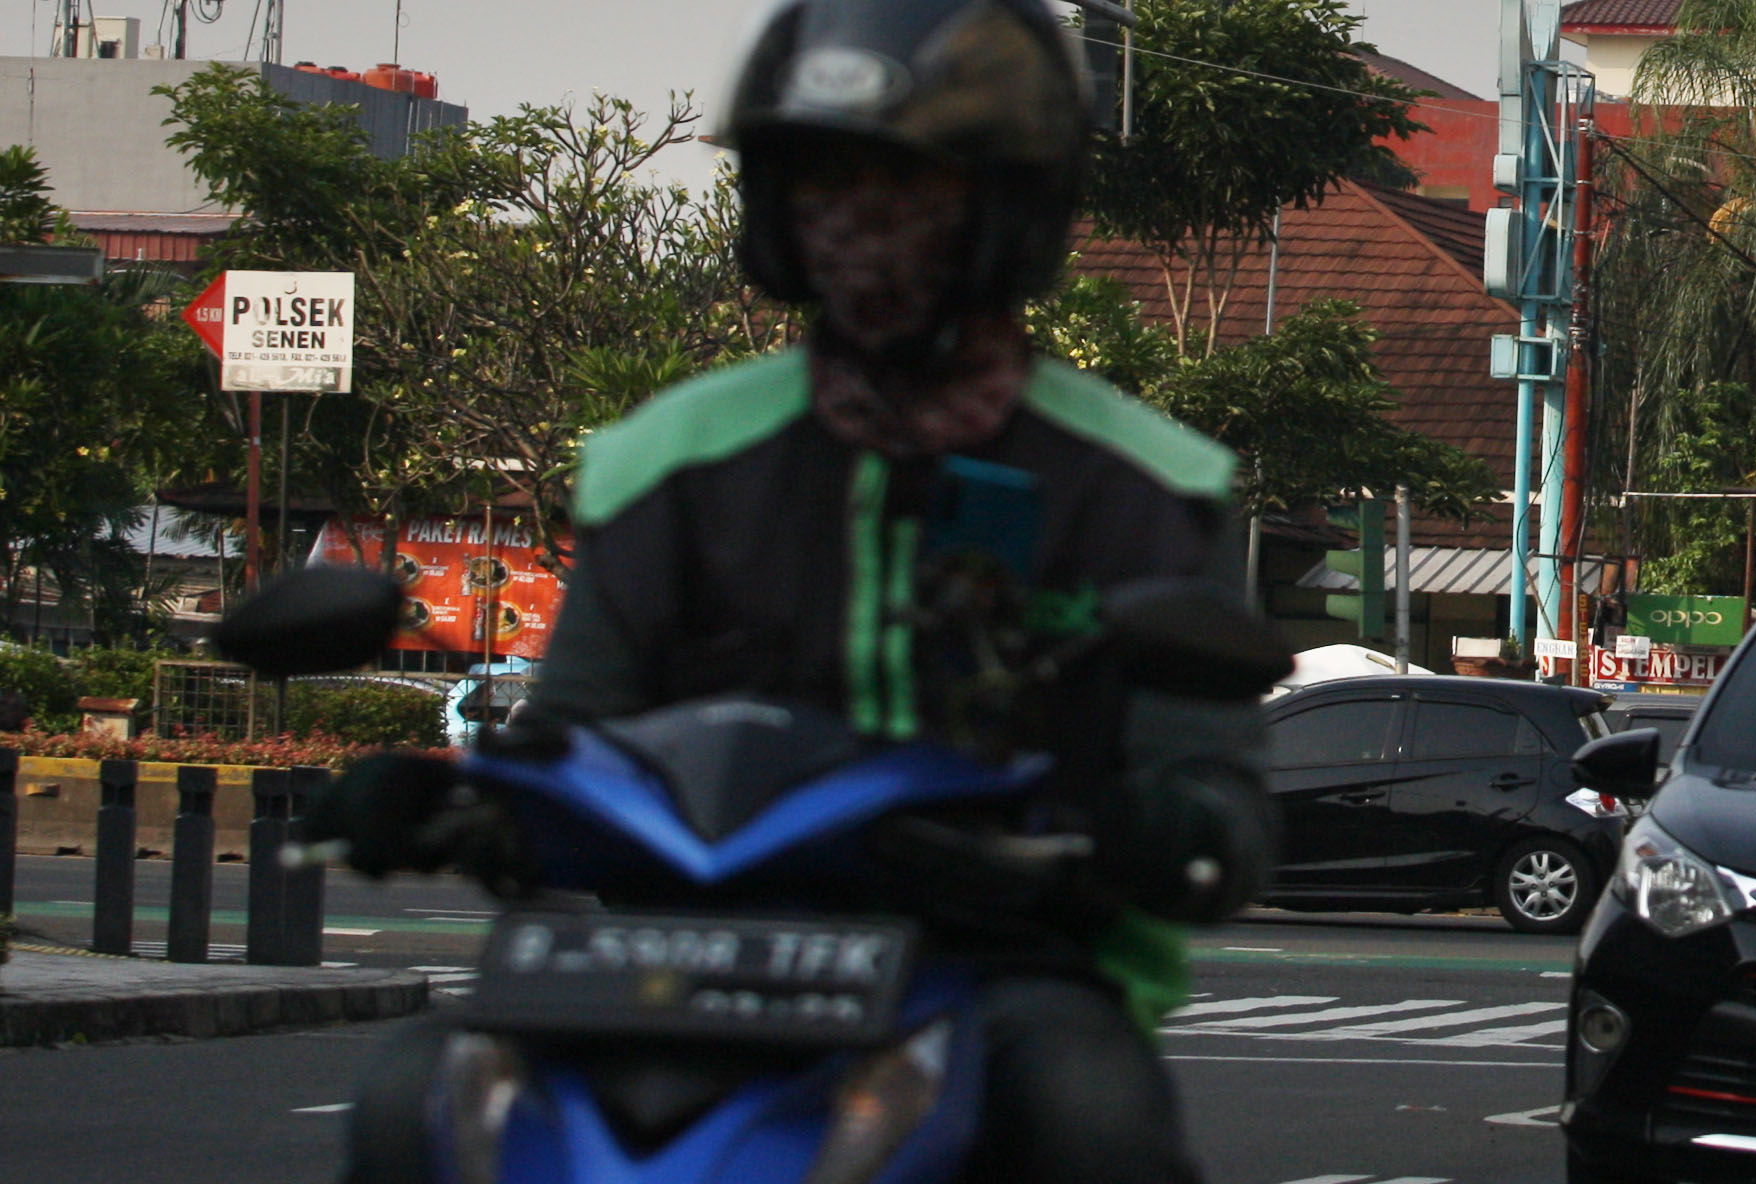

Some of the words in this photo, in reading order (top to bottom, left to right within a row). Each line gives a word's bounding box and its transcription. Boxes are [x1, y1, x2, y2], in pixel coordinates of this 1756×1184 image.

[231, 296, 346, 327] POLSEK
[252, 330, 326, 349] SENEN
[406, 520, 463, 545] PAKET
[1600, 650, 1719, 680] STEMPEL
